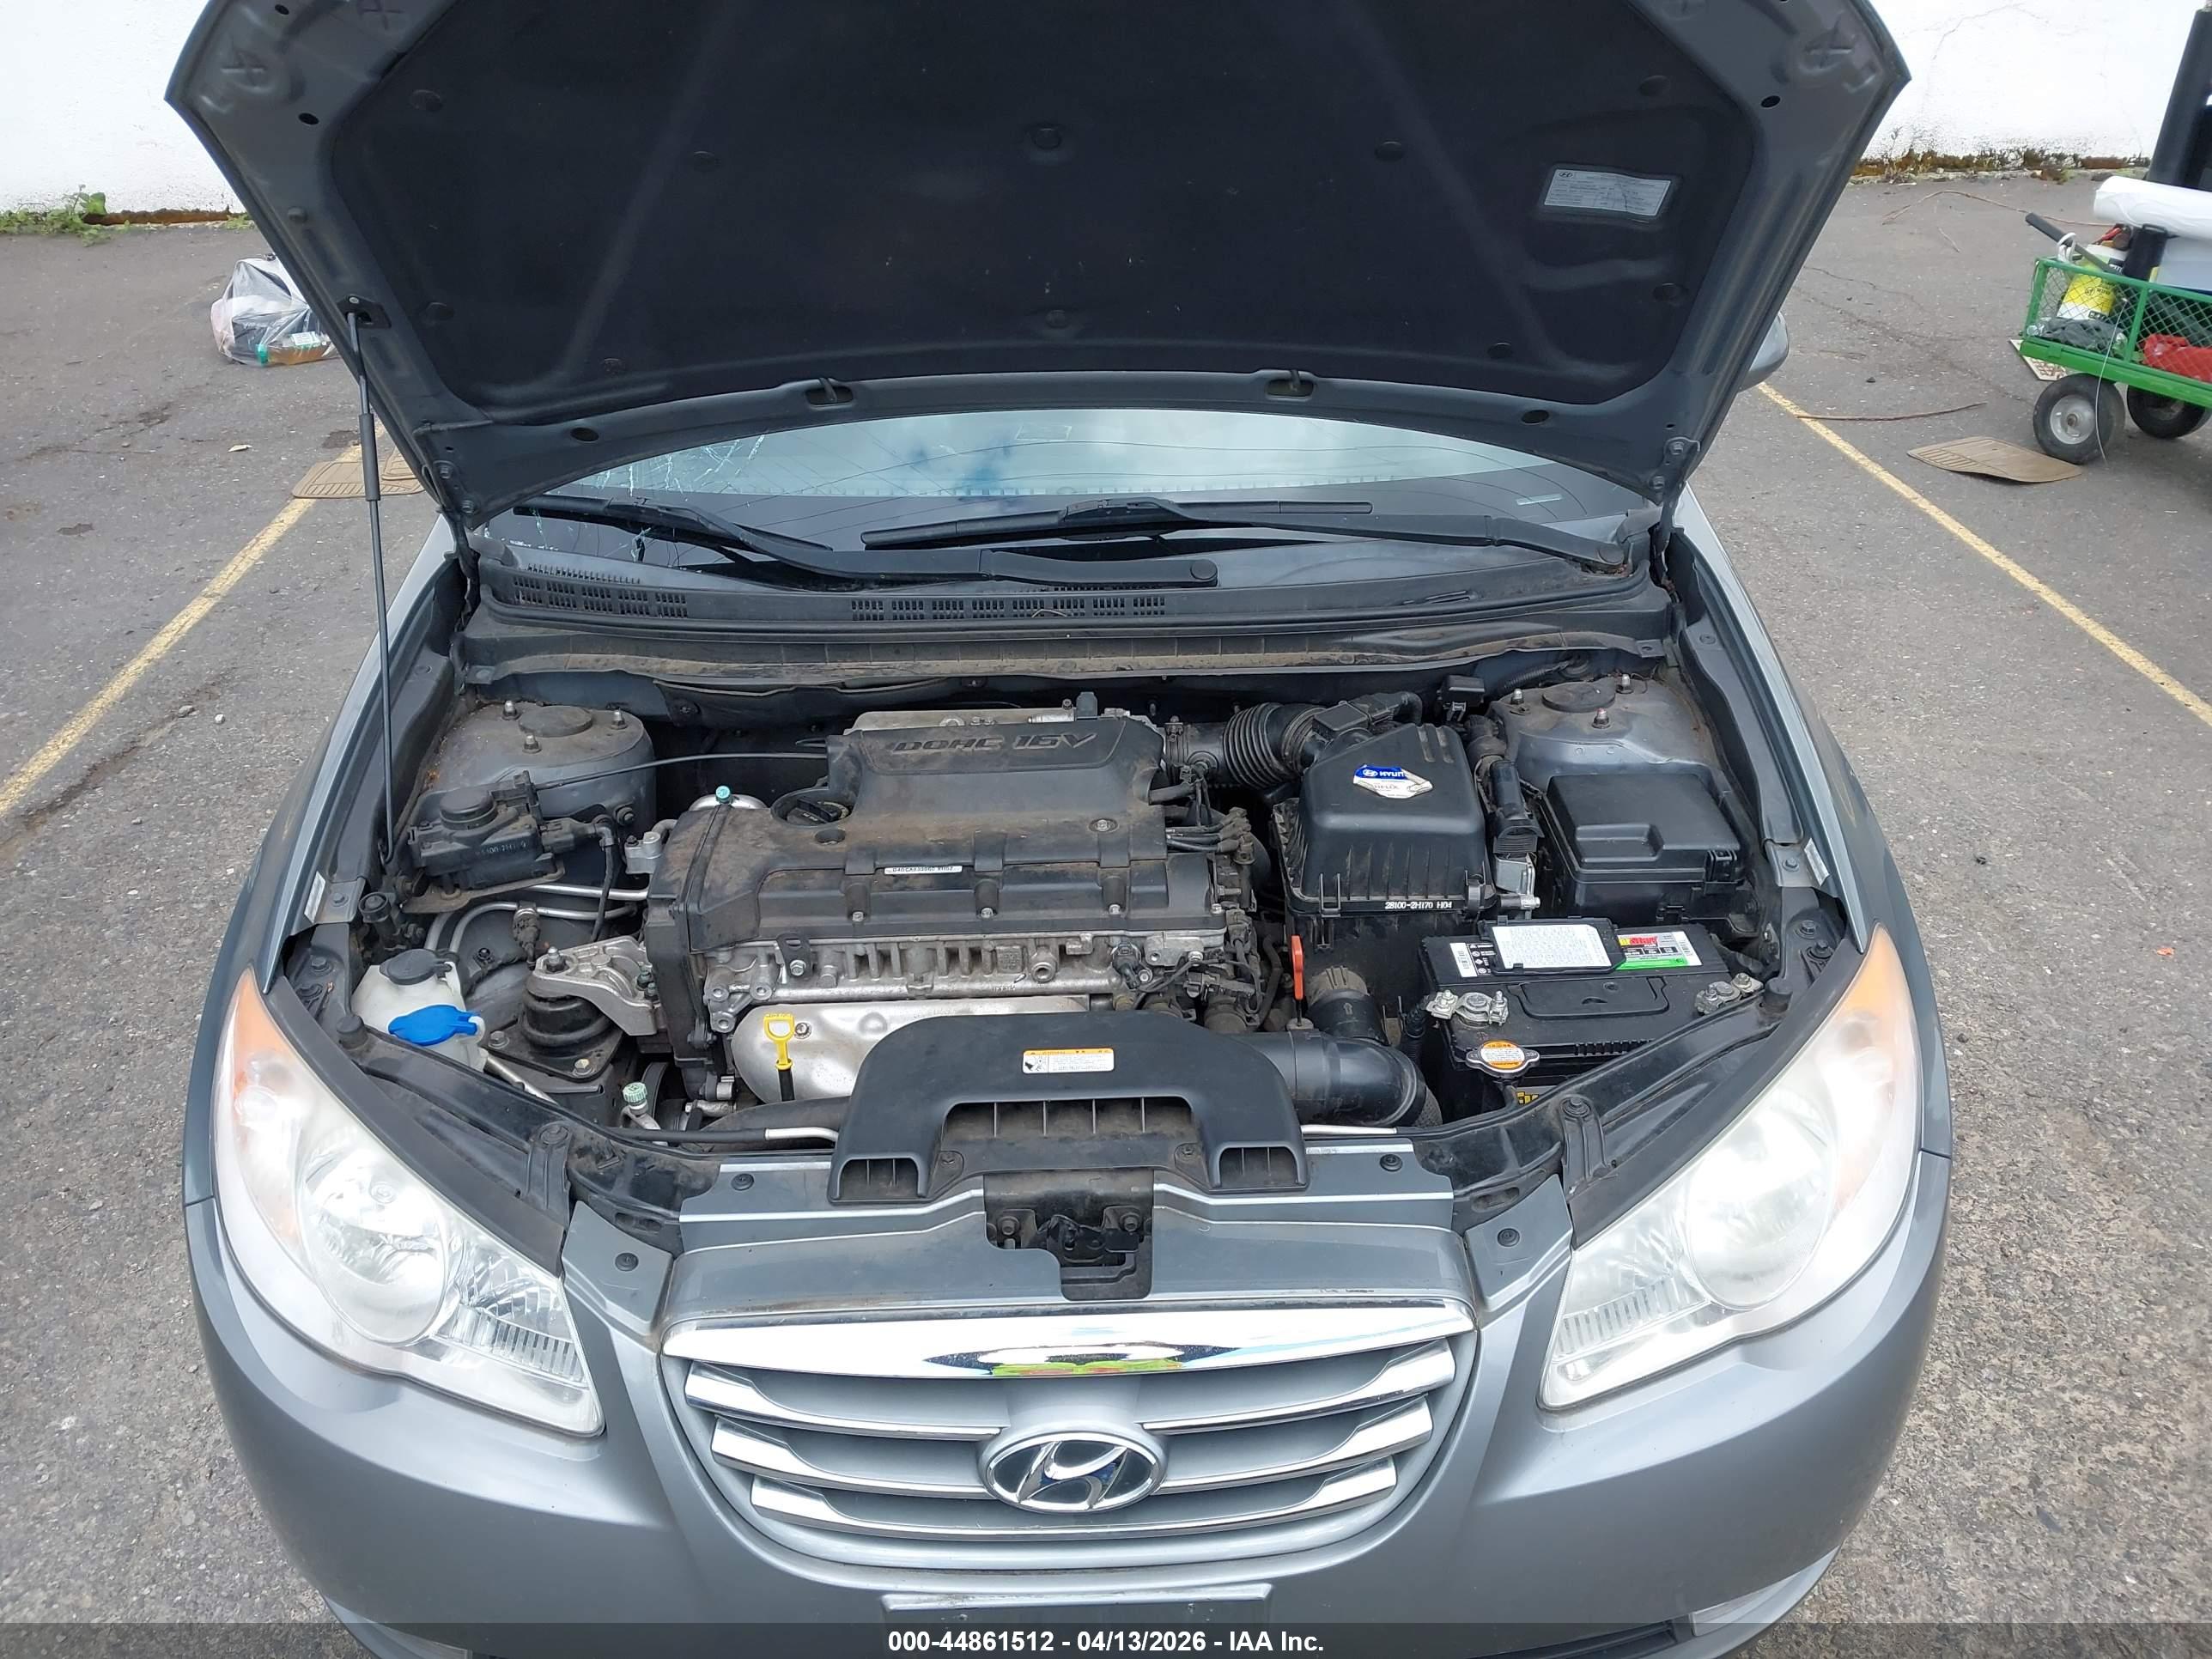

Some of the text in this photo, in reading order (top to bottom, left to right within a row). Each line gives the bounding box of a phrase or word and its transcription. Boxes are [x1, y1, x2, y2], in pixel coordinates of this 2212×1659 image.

[891, 732, 1097, 754] DOHC 16V
[1384, 901, 1453, 909] 28100-2H170 H04
